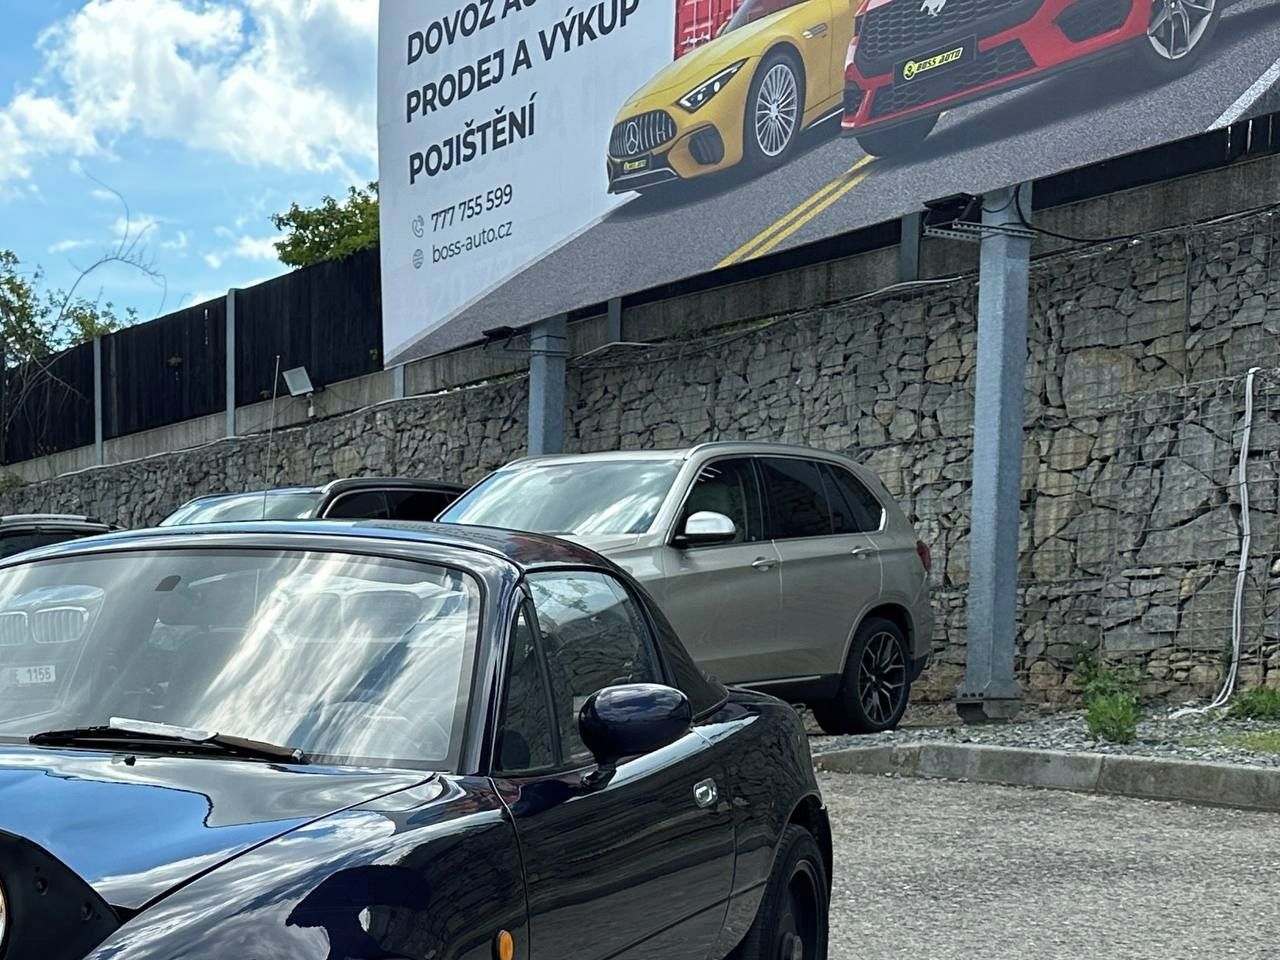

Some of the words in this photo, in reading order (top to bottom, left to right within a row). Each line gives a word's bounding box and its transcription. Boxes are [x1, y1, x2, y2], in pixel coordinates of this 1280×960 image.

[406, 49, 505, 123] PRODEJ
[511, 39, 533, 76] A
[538, 0, 639, 61] VÝKUP
[407, 0, 496, 65] DOVOZ
[408, 92, 538, 185] POJIŠTĚNÍ
[431, 205, 456, 233] 777
[458, 195, 483, 222] 755
[485, 183, 513, 212] 599
[432, 221, 513, 264] boss-auto.cz
